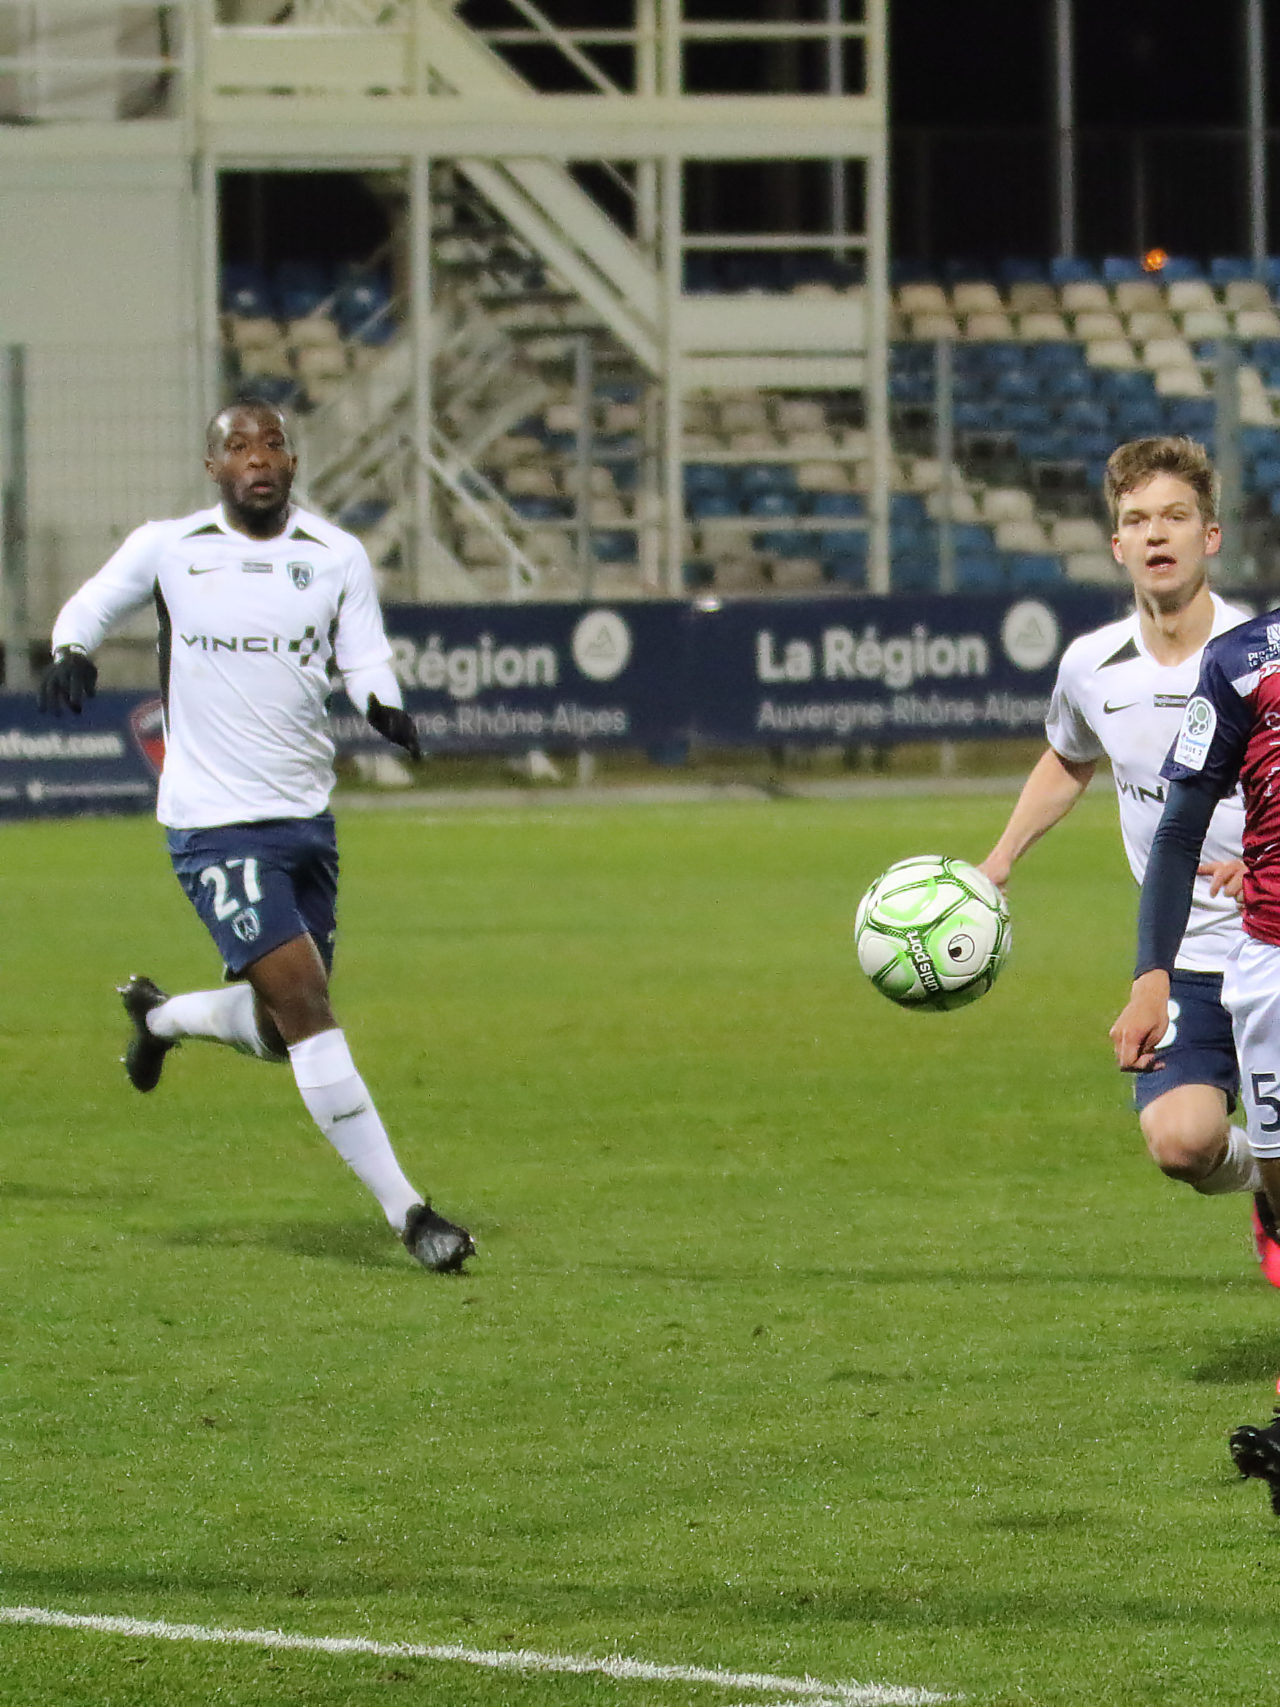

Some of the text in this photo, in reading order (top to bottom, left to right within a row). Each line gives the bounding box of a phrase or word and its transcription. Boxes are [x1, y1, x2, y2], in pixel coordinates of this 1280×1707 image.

[180, 634, 279, 653] VINCI
[390, 631, 558, 698] Région
[757, 622, 991, 690] La Région
[1117, 777, 1166, 803] VIN
[200, 858, 262, 921] 27
[906, 929, 940, 992] uhlsport
